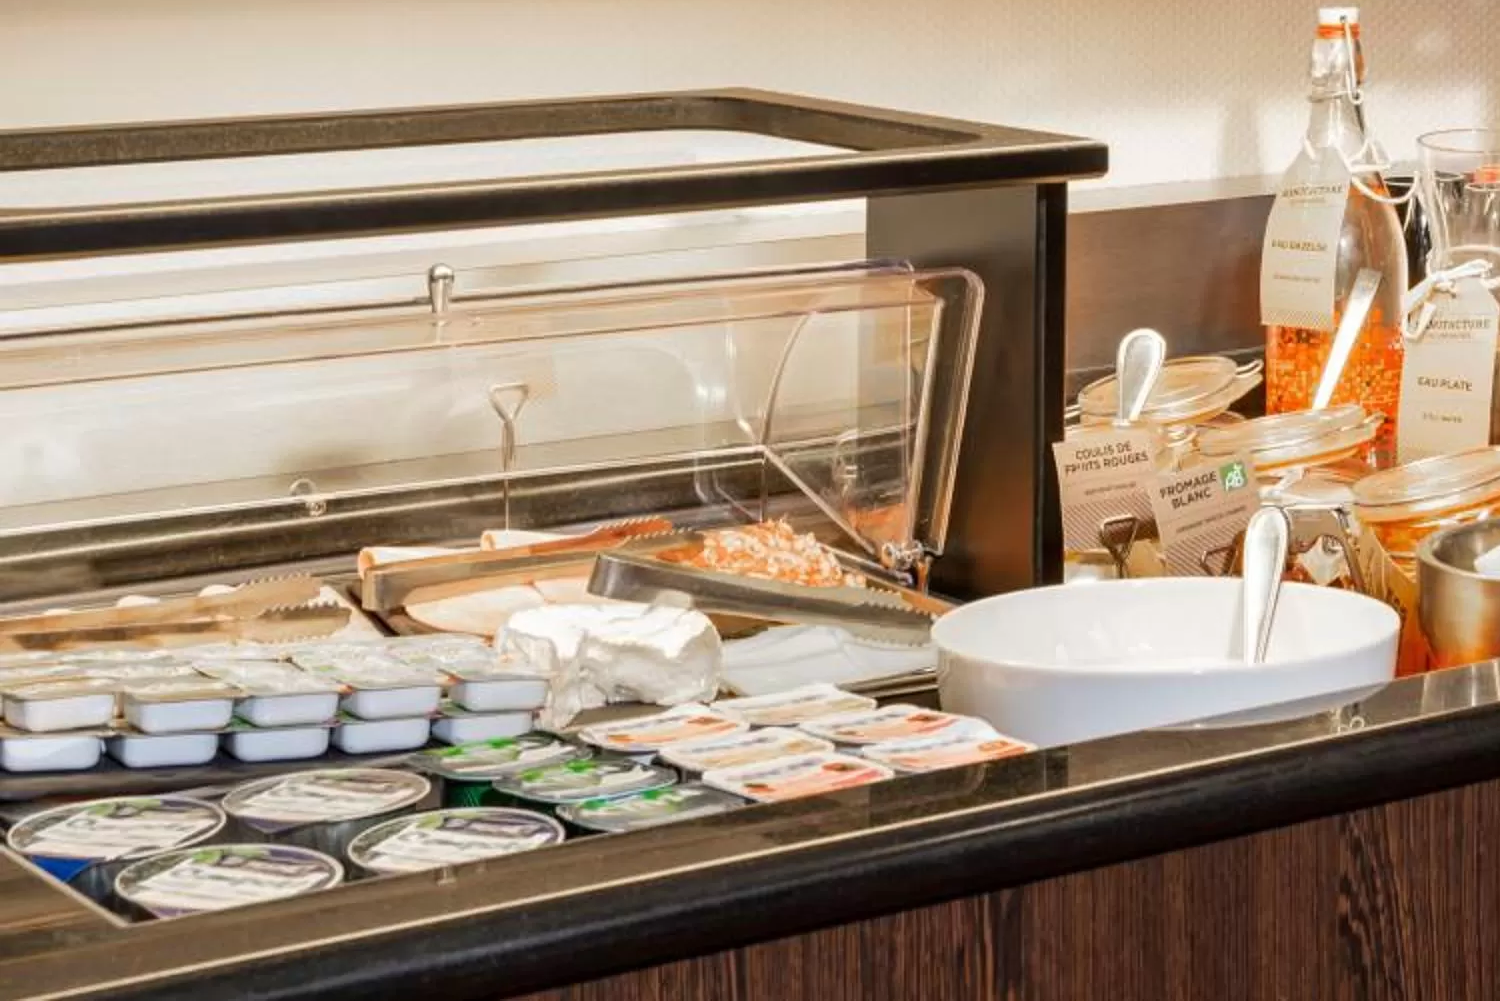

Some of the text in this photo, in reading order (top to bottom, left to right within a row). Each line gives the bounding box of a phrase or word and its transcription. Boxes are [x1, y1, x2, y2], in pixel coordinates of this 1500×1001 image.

[1417, 376, 1438, 388] EAU
[1116, 440, 1132, 452] DE
[1159, 470, 1218, 499] FROMAGE
[1171, 486, 1212, 510] BLANC
